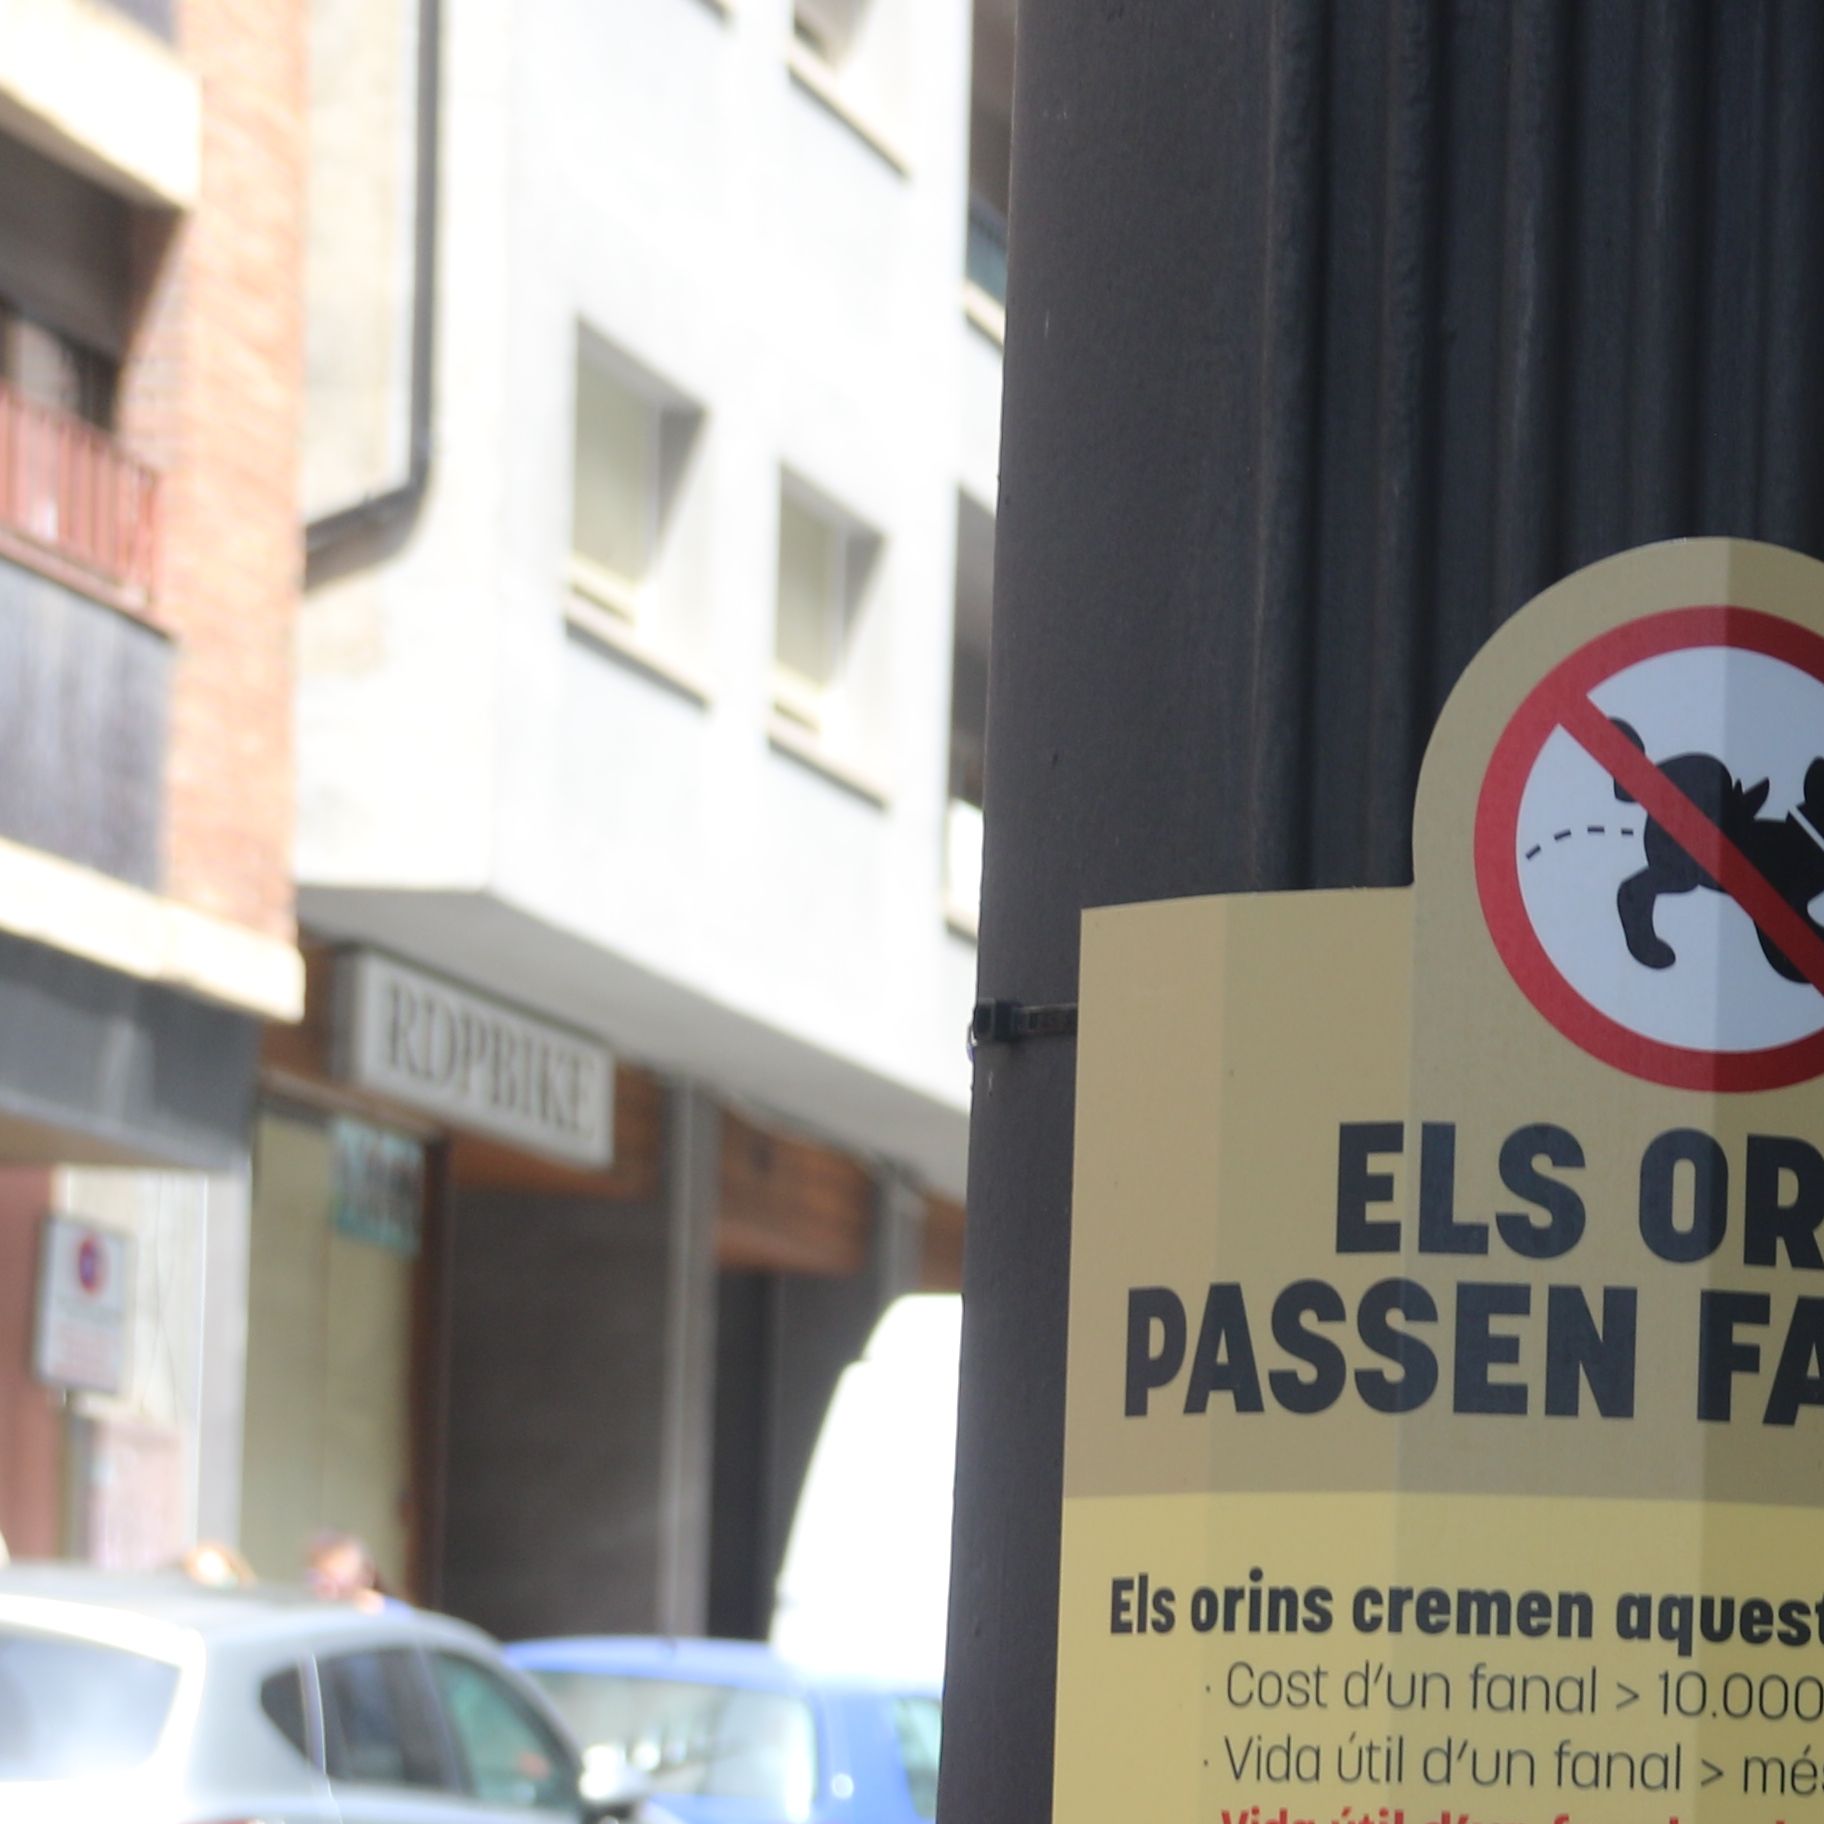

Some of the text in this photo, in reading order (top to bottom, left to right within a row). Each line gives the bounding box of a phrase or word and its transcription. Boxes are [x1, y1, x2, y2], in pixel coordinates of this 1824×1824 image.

[1335, 1121, 1587, 1260] ELS
[1124, 1277, 1638, 1419] PASSEN
[1110, 1572, 1176, 1635] Els
[1190, 1567, 1333, 1634] orins
[1352, 1585, 1594, 1638] cremen
[1225, 1661, 1328, 1709] Cost
[1343, 1660, 1451, 1710] d'un
[1469, 1663, 1598, 1714] fanal
[1657, 1670, 1824, 1725] 10.000
[1223, 1734, 1320, 1784] Vida
[1336, 1731, 1404, 1785] útil
[1422, 1736, 1535, 1787] d'un
[1554, 1739, 1682, 1791] fanal
